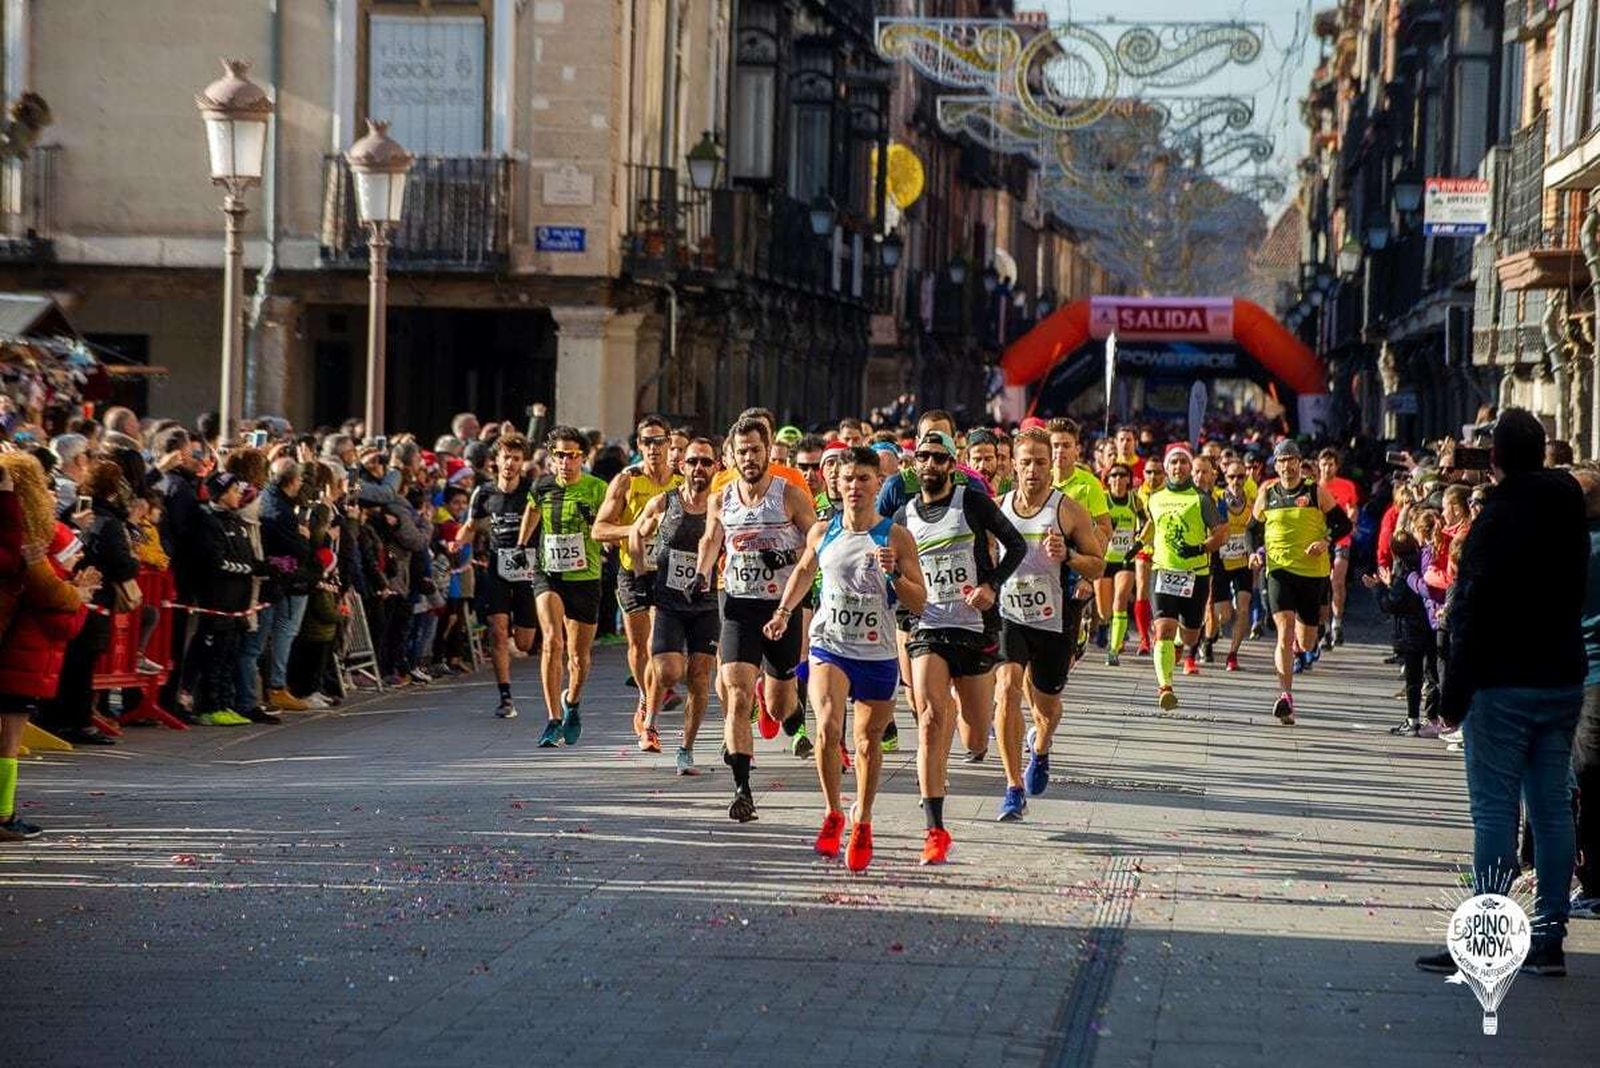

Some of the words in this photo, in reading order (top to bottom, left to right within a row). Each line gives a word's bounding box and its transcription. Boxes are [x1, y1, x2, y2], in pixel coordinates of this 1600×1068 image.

[1120, 309, 1204, 329] SALIDA
[550, 546, 580, 560] 1125
[732, 566, 774, 581] 1670
[925, 567, 967, 587] 1418
[1165, 571, 1188, 586] 322
[1007, 591, 1046, 608] 1130
[831, 608, 878, 627] 1076
